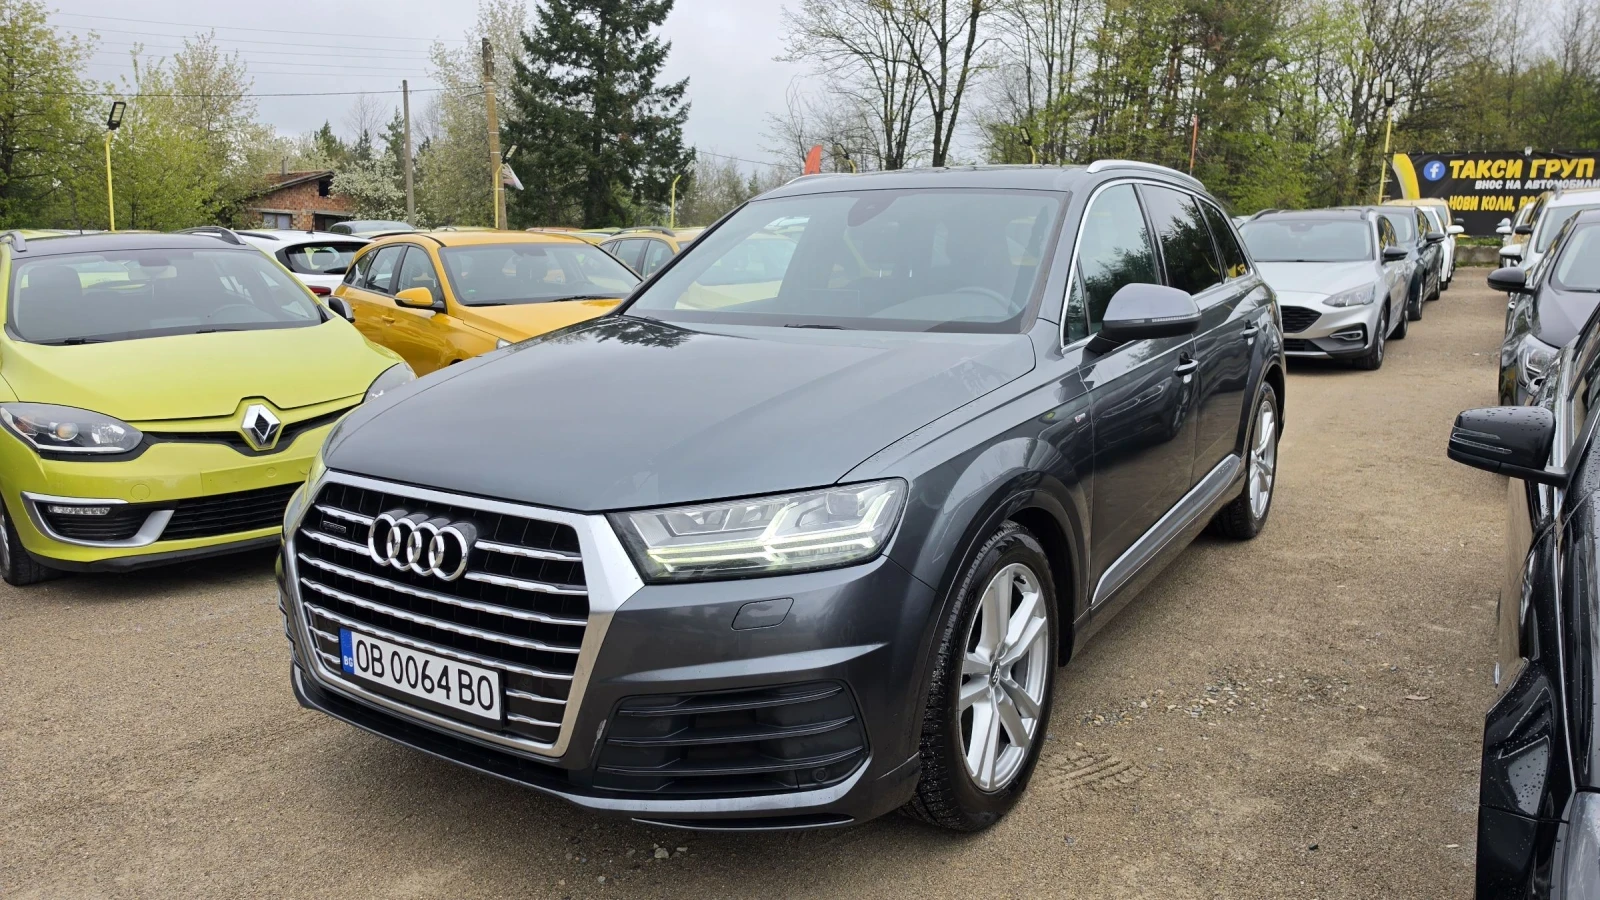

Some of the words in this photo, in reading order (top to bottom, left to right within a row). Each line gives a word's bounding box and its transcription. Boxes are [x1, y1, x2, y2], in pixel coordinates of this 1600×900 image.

[1450, 159, 1523, 179] ТАКСИ
[1529, 158, 1595, 179] ГРУП
[1475, 180, 1503, 190] ВНОС
[1505, 180, 1521, 190] НА
[1449, 195, 1479, 211] НОВИ
[1481, 195, 1515, 212] КОЛИ,
[343, 655, 354, 668] BG
[356, 639, 385, 678] OB
[390, 650, 451, 700] 0064
[457, 668, 494, 711] BO
